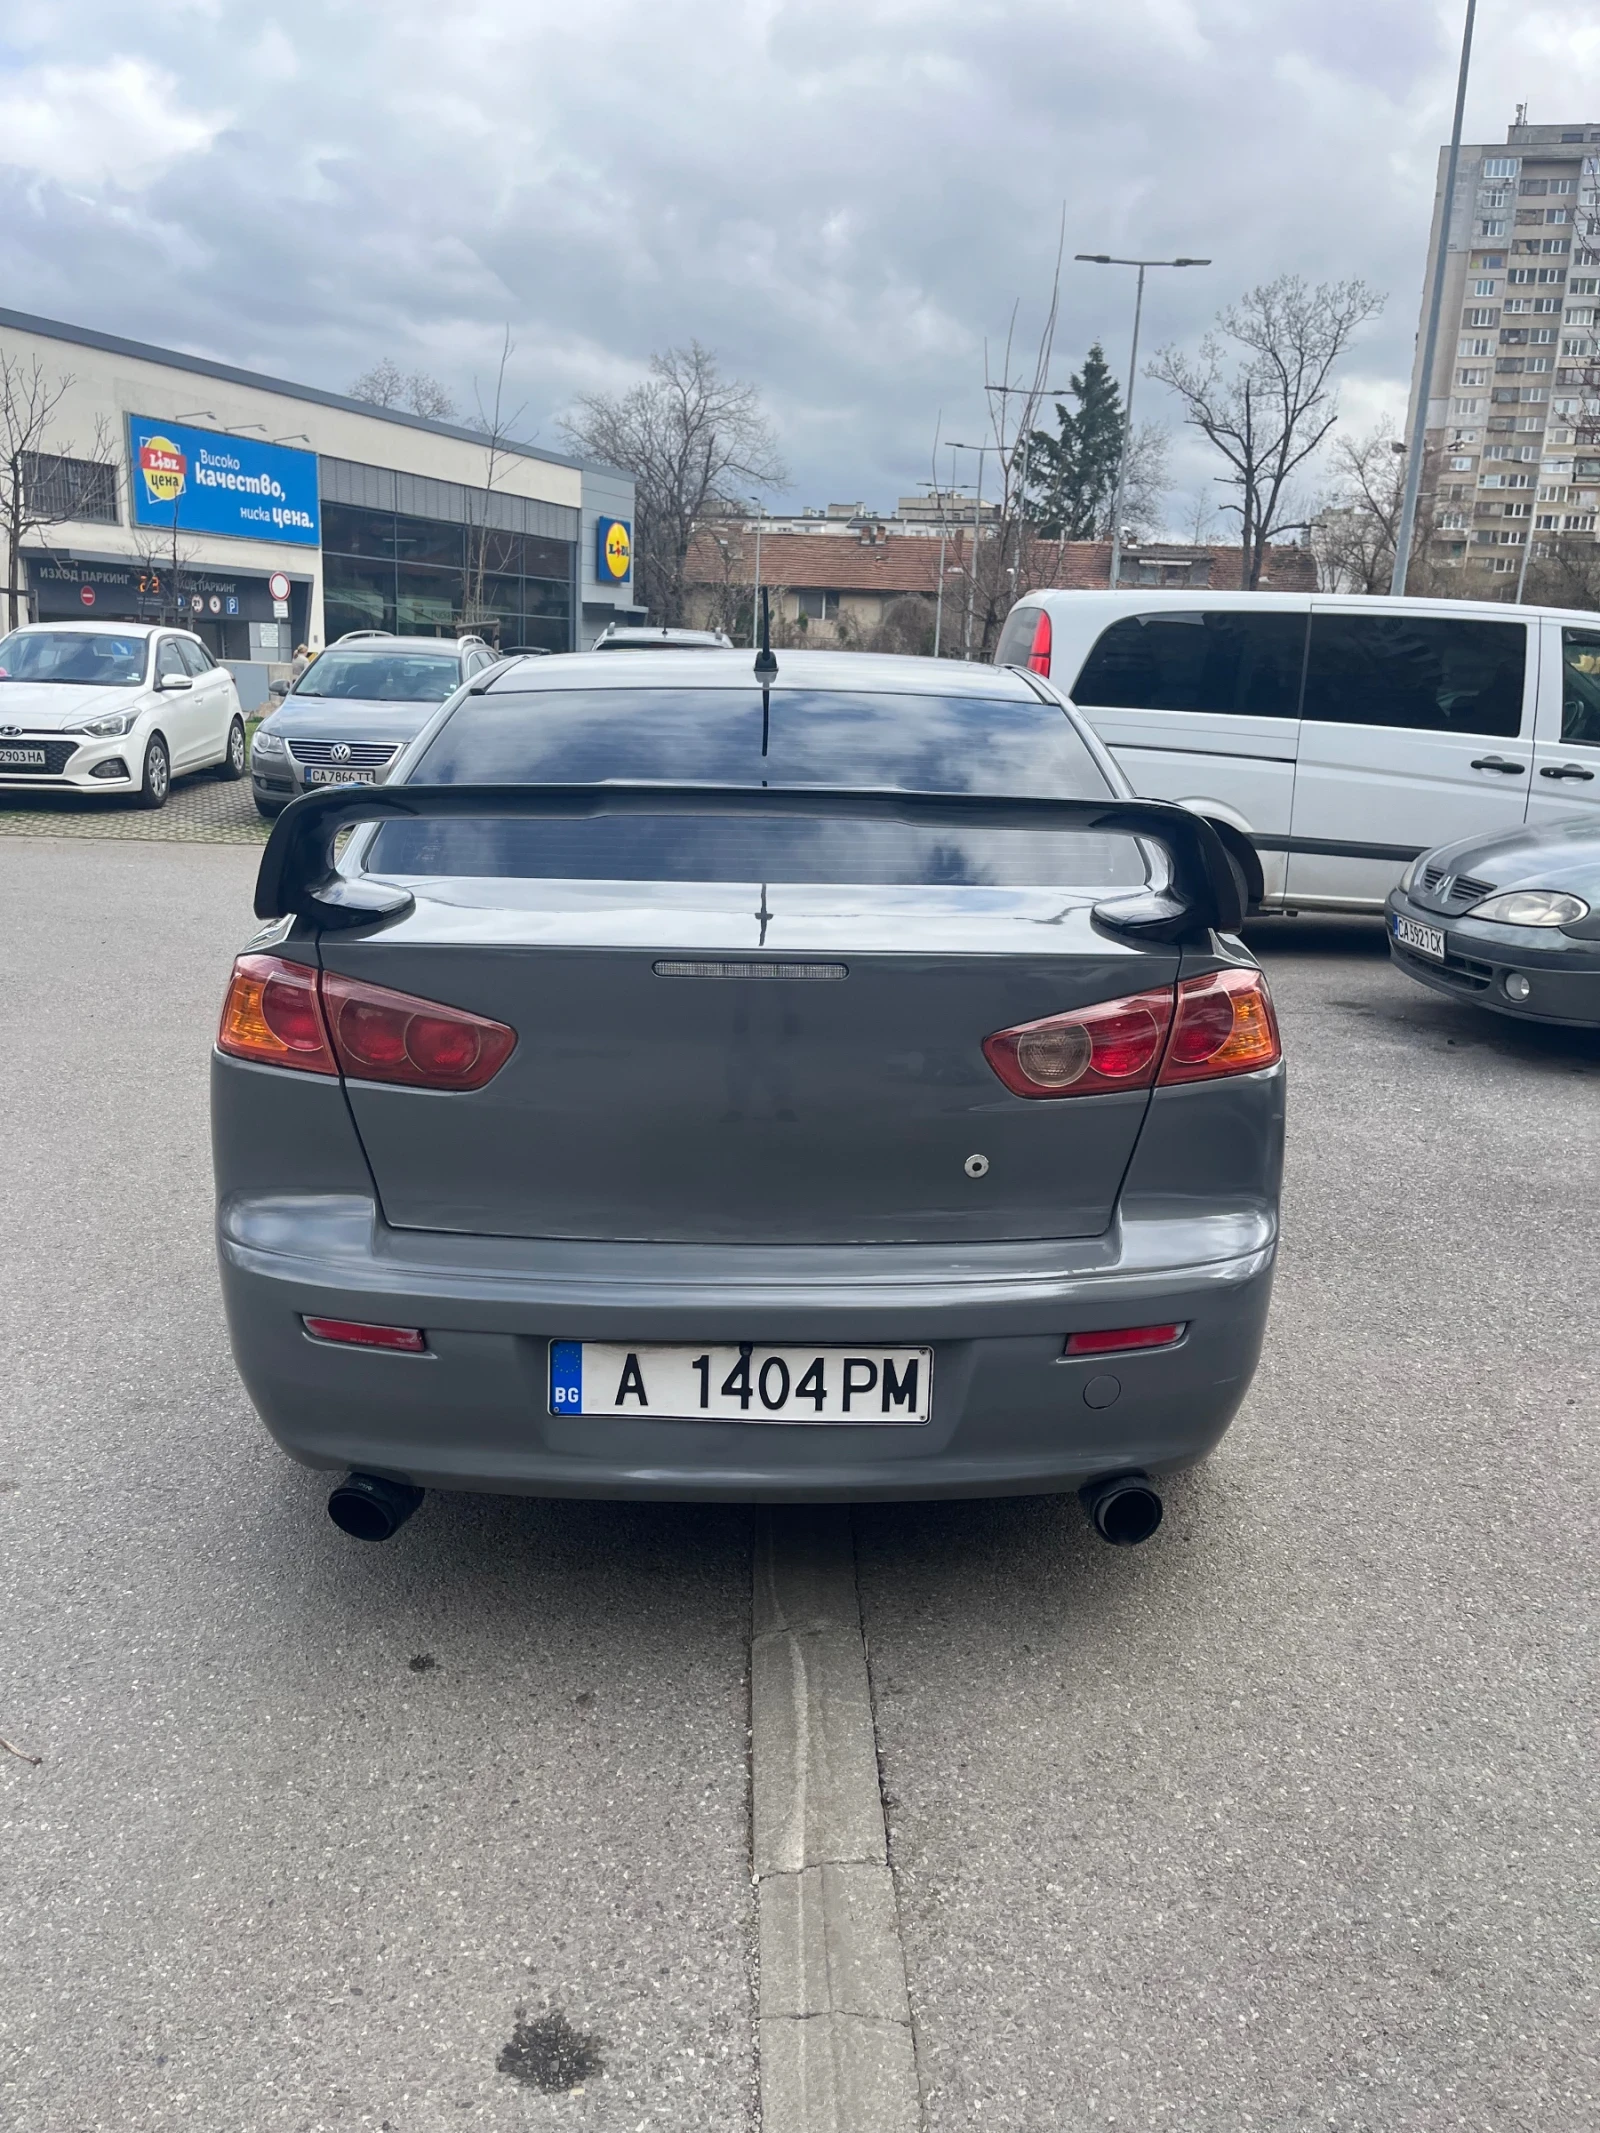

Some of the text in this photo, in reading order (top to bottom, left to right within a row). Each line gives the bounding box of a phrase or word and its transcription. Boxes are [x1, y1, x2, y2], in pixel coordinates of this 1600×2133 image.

[199, 449, 240, 470] Високо
[151, 474, 179, 490] цена
[195, 462, 286, 502] качество,
[240, 506, 314, 528] ниска цена.
[40, 567, 130, 584] ИЗХОД ПАРКИНГ
[198, 580, 236, 593] ПАРКИНГ
[554, 1387, 579, 1403] BG
